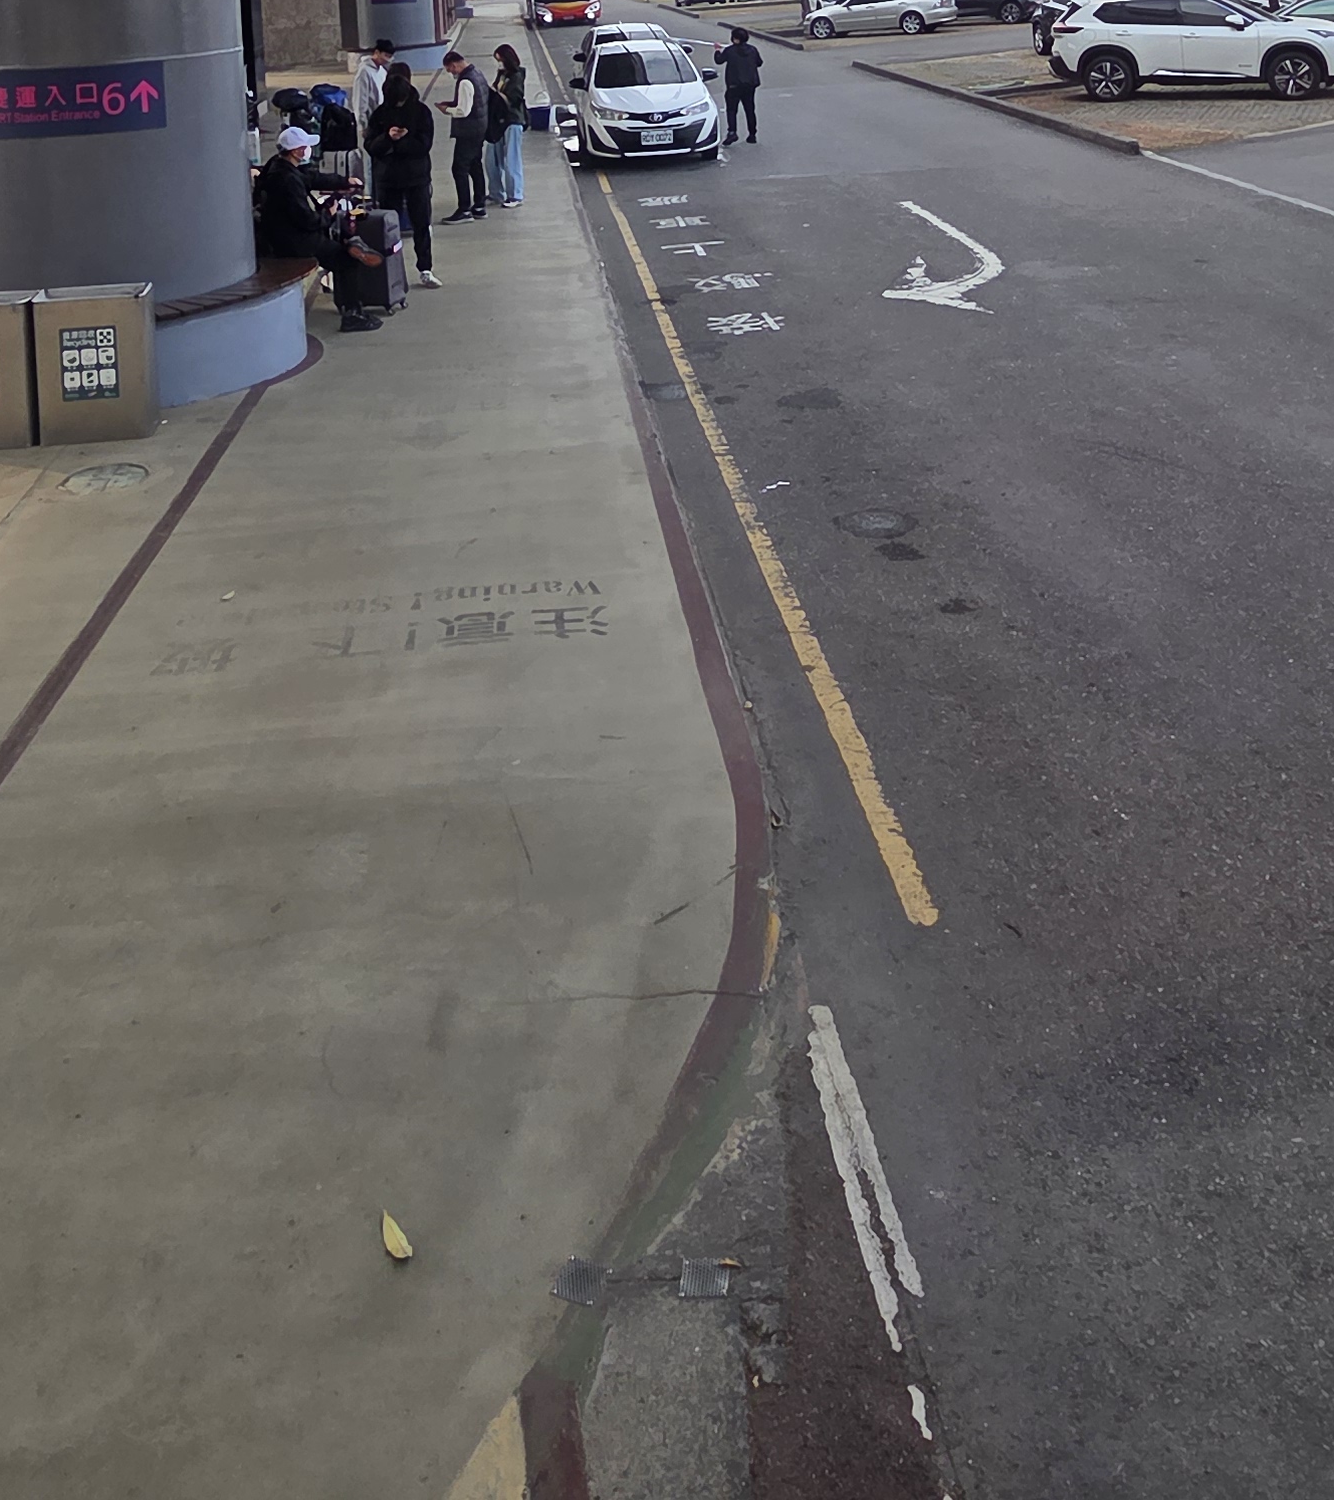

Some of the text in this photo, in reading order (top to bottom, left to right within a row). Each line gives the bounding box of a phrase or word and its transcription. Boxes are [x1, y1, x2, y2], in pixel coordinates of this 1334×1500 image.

[102, 82, 125, 115] 6
[13, 111, 49, 124] Station
[51, 110, 101, 122] Entrance
